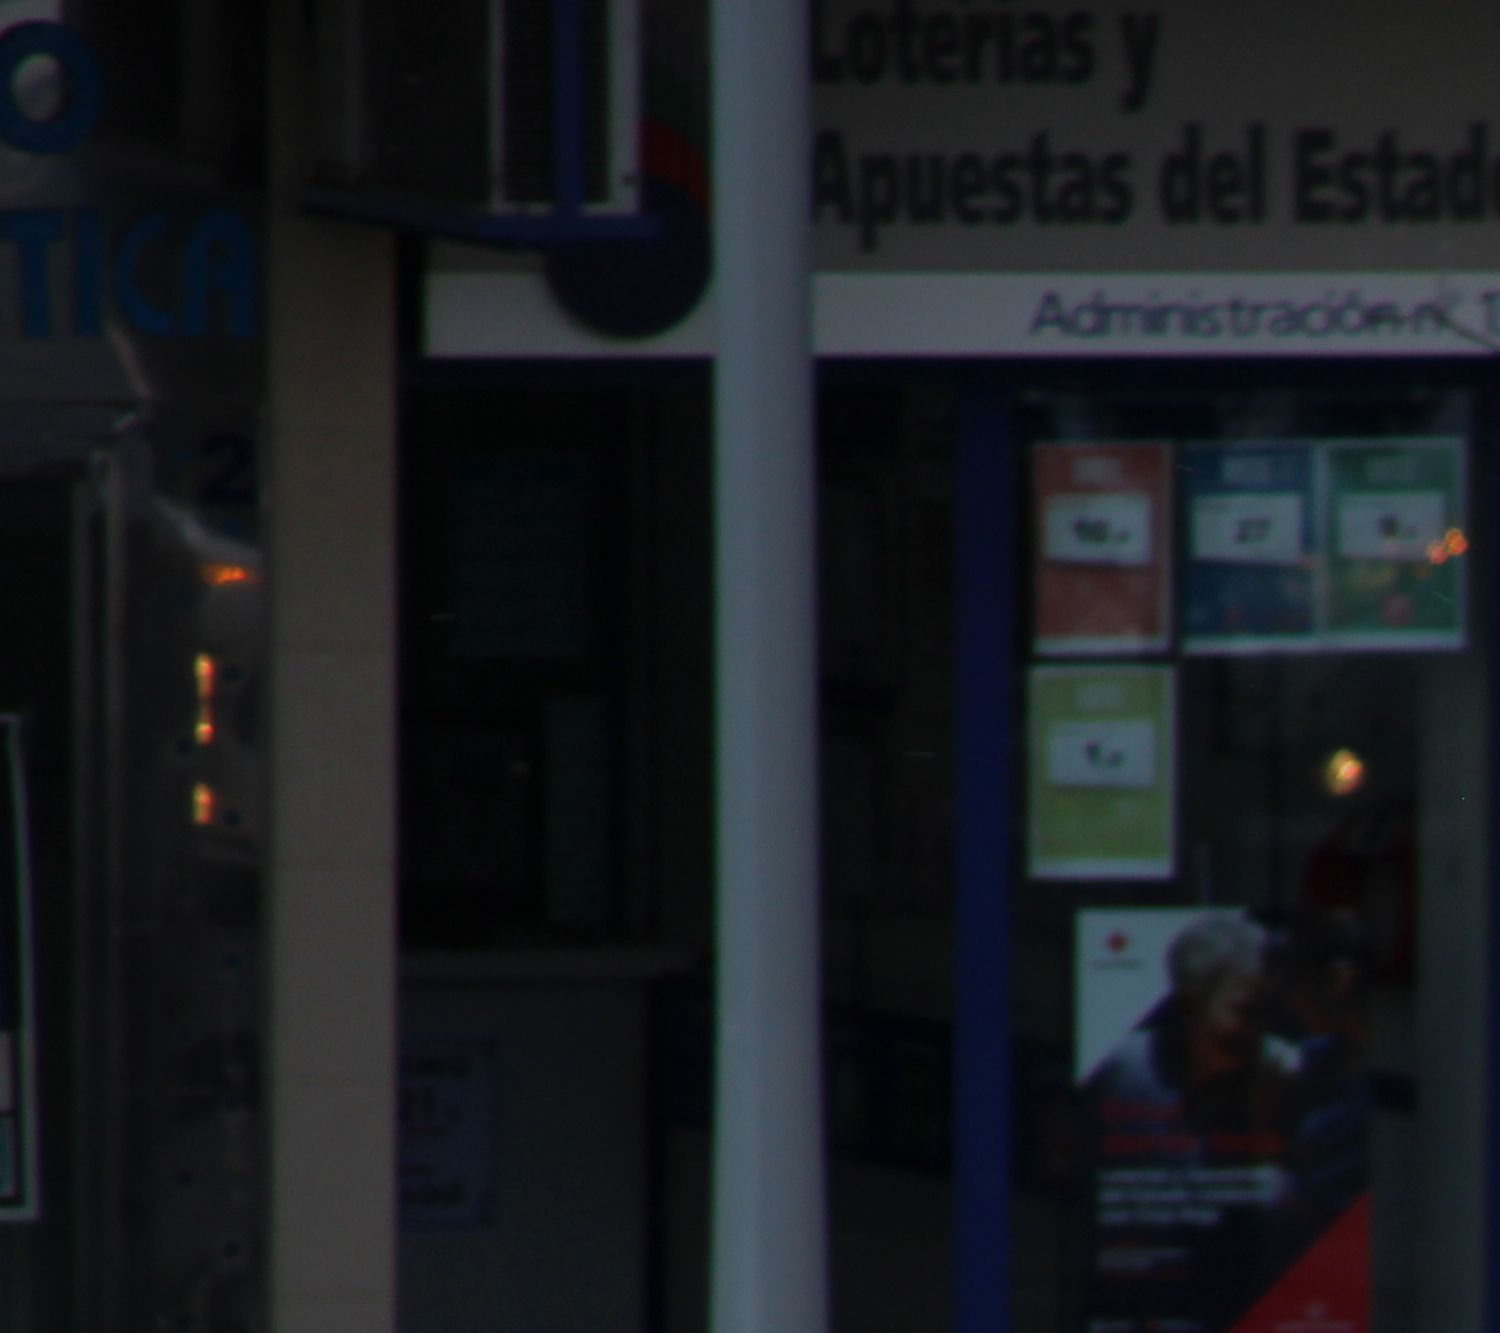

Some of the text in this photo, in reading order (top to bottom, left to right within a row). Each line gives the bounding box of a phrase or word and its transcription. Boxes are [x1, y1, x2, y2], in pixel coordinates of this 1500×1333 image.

[1120, 8, 1160, 112] y
[813, 128, 1134, 250] Apuestas
[1160, 122, 1265, 226] del
[1031, 290, 1400, 338] Administración
